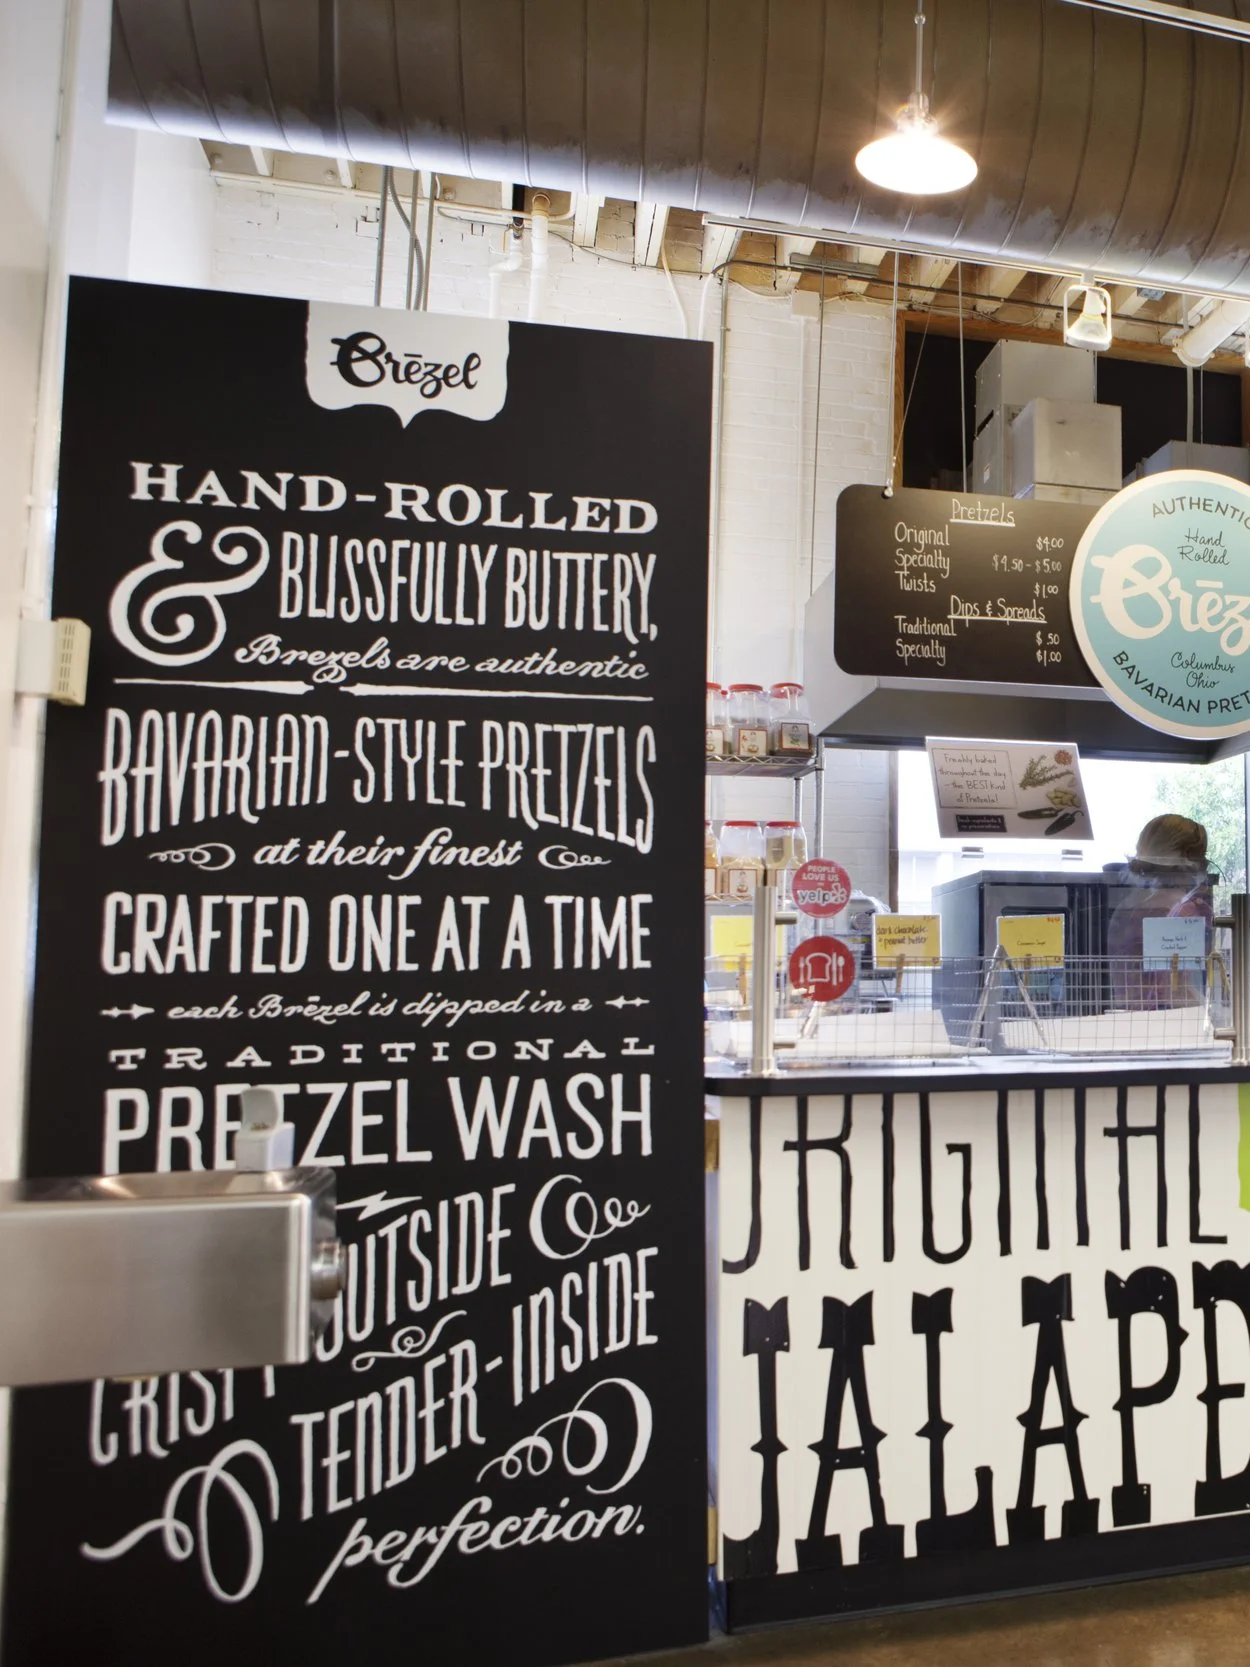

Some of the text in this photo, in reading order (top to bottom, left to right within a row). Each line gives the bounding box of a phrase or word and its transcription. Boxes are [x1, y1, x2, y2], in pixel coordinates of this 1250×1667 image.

[130, 461, 658, 534] HAND-ROLLED
[952, 498, 1015, 524] Pretzels
[895, 521, 1065, 553] Original $4.00
[1185, 527, 1226, 548] Hand
[895, 548, 950, 578] Specialty
[1177, 545, 1231, 566] Rolled
[109, 520, 658, 667] & BLISSFULLY BUTTERY,
[895, 570, 1059, 598] Twists $1.00
[894, 615, 957, 637] Traditional
[951, 595, 1046, 628] Dips & Spreads
[234, 633, 649, 684] Brezels are authentic
[896, 638, 1062, 667] Specialty $1.00
[1170, 651, 1236, 674] Columbus
[1112, 650, 1201, 714] BAVARIAN
[1186, 670, 1220, 689] Ohio
[943, 752, 997, 766] Freshly baked
[98, 707, 657, 855] BAVARIAN-STYLE PRETZELS
[966, 779, 988, 791] BEST
[989, 780, 1006, 791] kind
[956, 792, 964, 803] of
[253, 826, 524, 881] at their finest
[801, 872, 840, 882] LOVE US
[807, 865, 837, 873] PEOPLE
[798, 888, 832, 906] yelp
[101, 891, 653, 975] CRAFTED ONE AT A TIME
[167, 993, 243, 1019] each
[368, 991, 398, 1017] is
[402, 990, 531, 1028] dipped
[529, 991, 566, 1013] in
[571, 998, 593, 1012] a
[109, 1037, 655, 1071] TRADITIONAL
[447, 1072, 653, 1161] WASH
[290, 1246, 659, 1520] TENDER-INSIDE
[308, 1496, 645, 1604] perfection.
